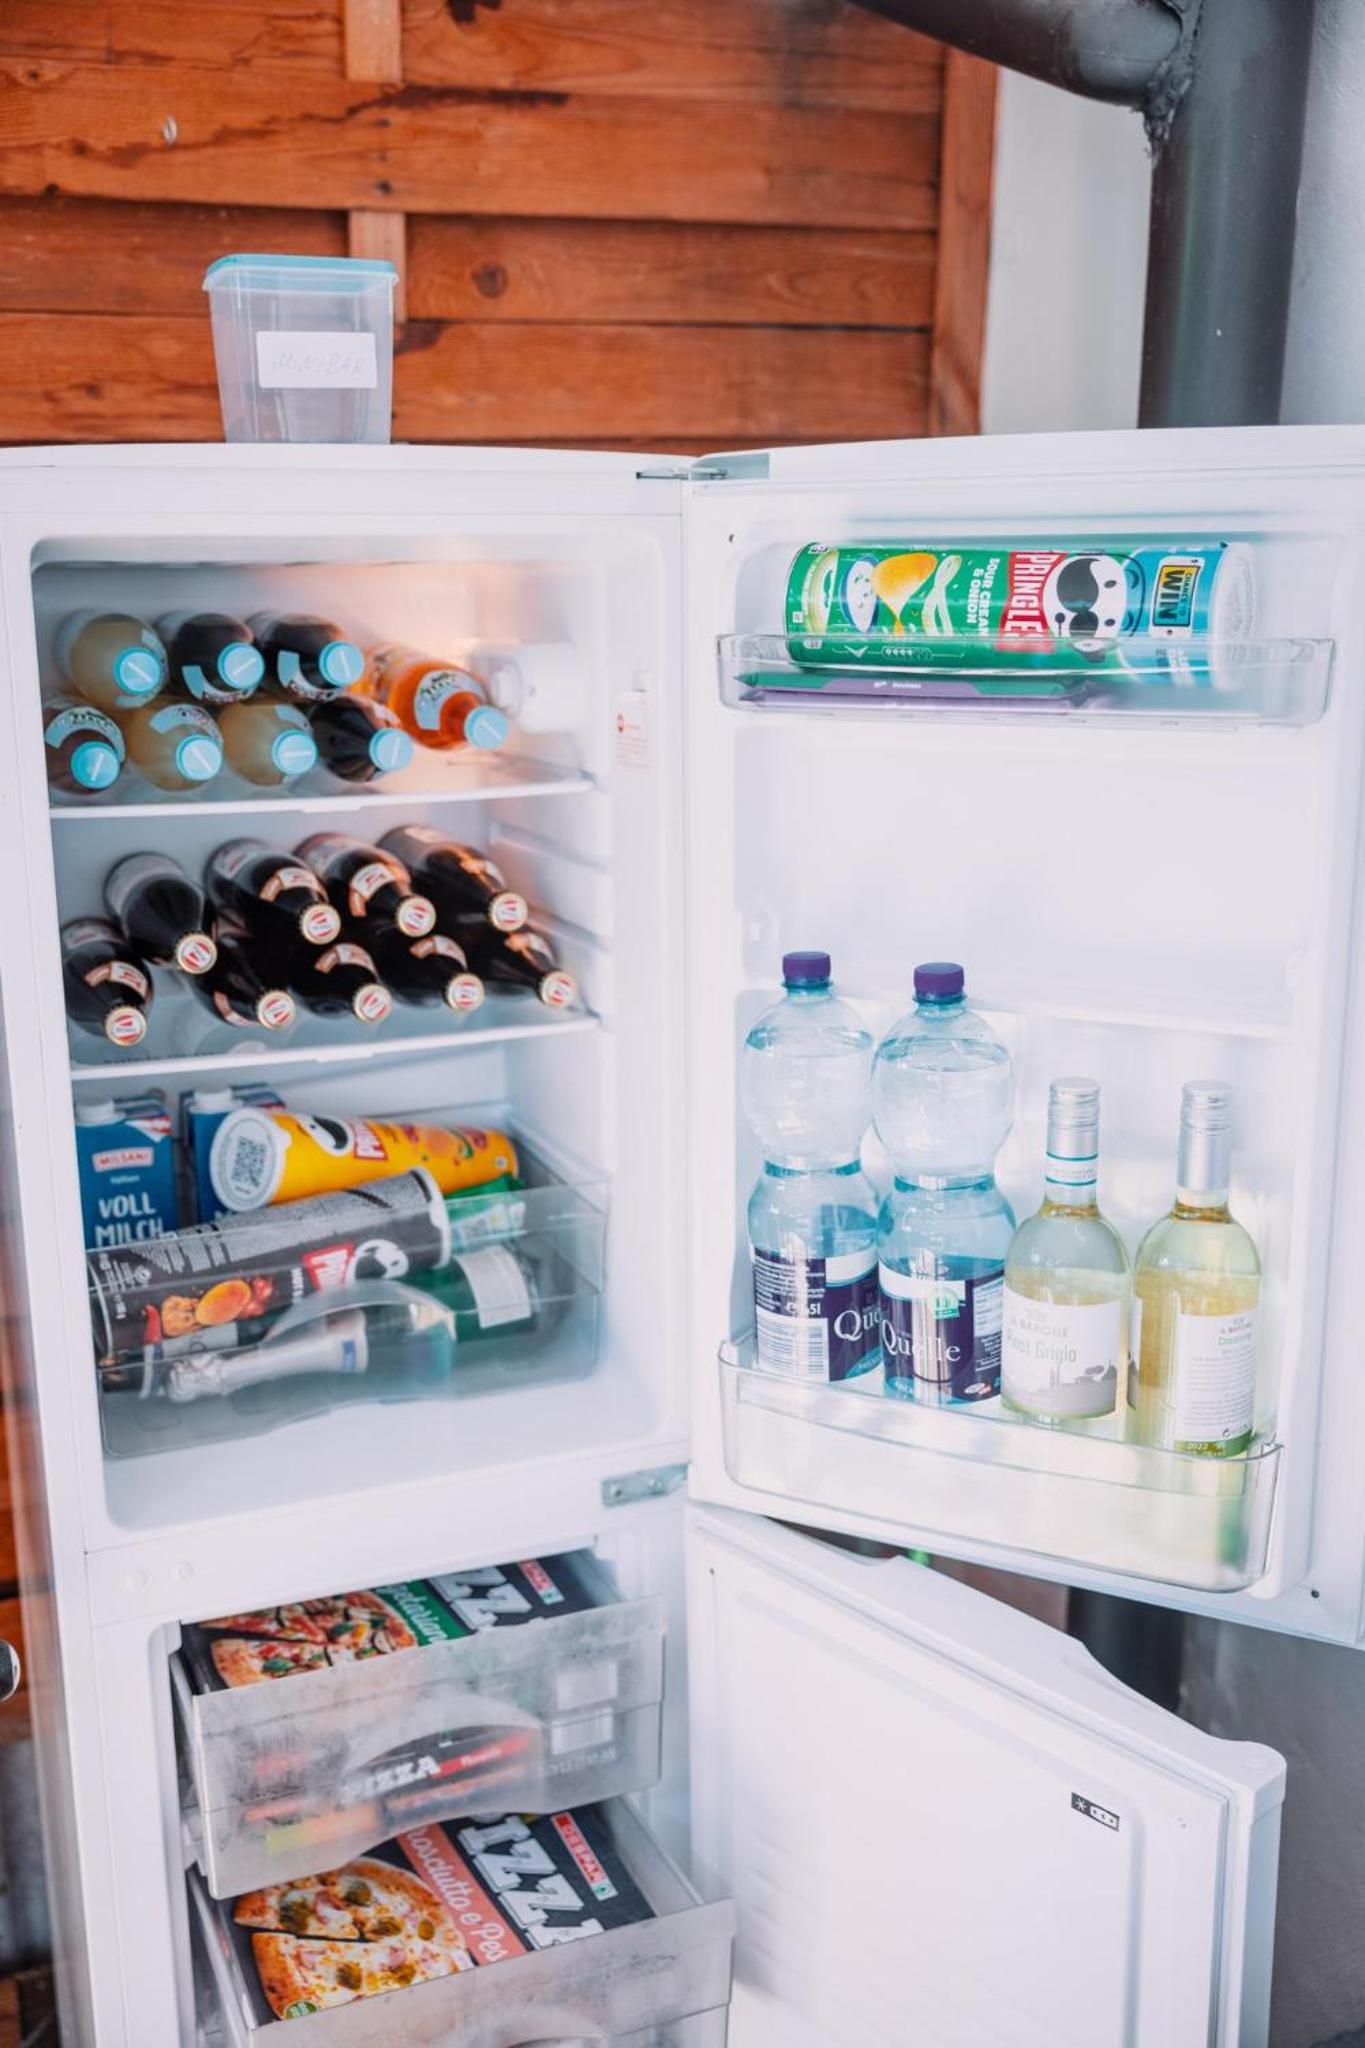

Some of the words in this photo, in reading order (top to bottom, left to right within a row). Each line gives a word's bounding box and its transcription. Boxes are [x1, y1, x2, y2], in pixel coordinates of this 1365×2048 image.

[983, 557, 1000, 589] SOUR
[1157, 569, 1185, 619] WIN
[966, 580, 981, 624] ONION
[98, 1191, 156, 1219] VOLL
[94, 1216, 165, 1248] MILCH
[406, 1823, 472, 1910] rosciutto
[470, 1922, 510, 1963] Pes
[458, 1813, 605, 1951] IZZA
